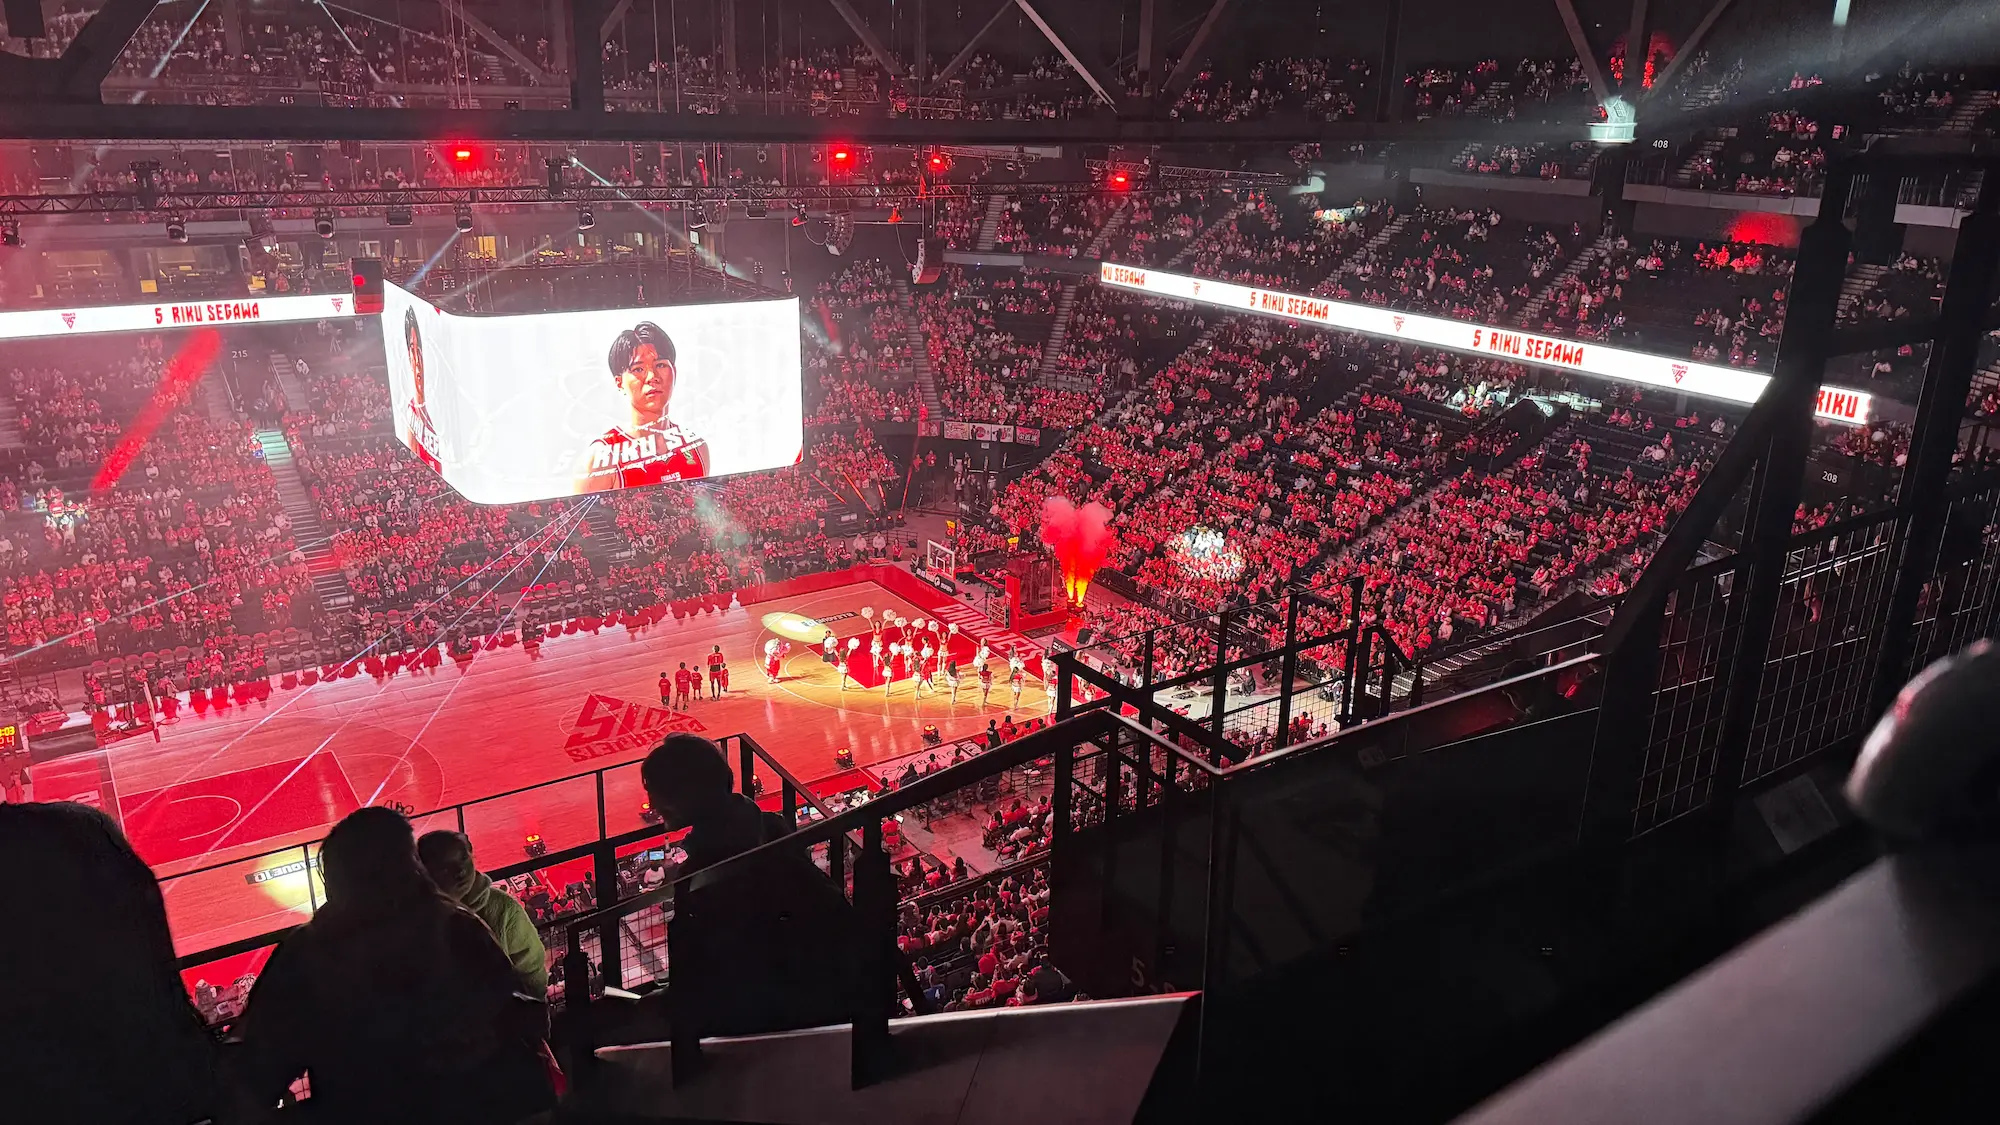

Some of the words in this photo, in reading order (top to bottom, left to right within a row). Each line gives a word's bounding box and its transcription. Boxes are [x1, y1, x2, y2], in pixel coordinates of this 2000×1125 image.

[849, 108, 860, 116] 412
[1652, 139, 1669, 149] 408
[1114, 268, 1146, 287] SEGAWA
[155, 307, 163, 324] 5
[172, 305, 203, 323] RIKU
[207, 302, 260, 322] SEGAWA
[1250, 291, 1257, 307] 5
[1262, 293, 1284, 313] RIKU
[1288, 297, 1329, 321] SEGAWA
[1166, 329, 1177, 337] 211
[232, 350, 248, 358] 215
[1473, 330, 1482, 348] 5
[1490, 332, 1521, 355] RIKU
[1526, 337, 1585, 366] SEGAWA
[1347, 362, 1359, 372] 210
[590, 433, 656, 469] RIKU
[1821, 470, 1838, 484] 208
